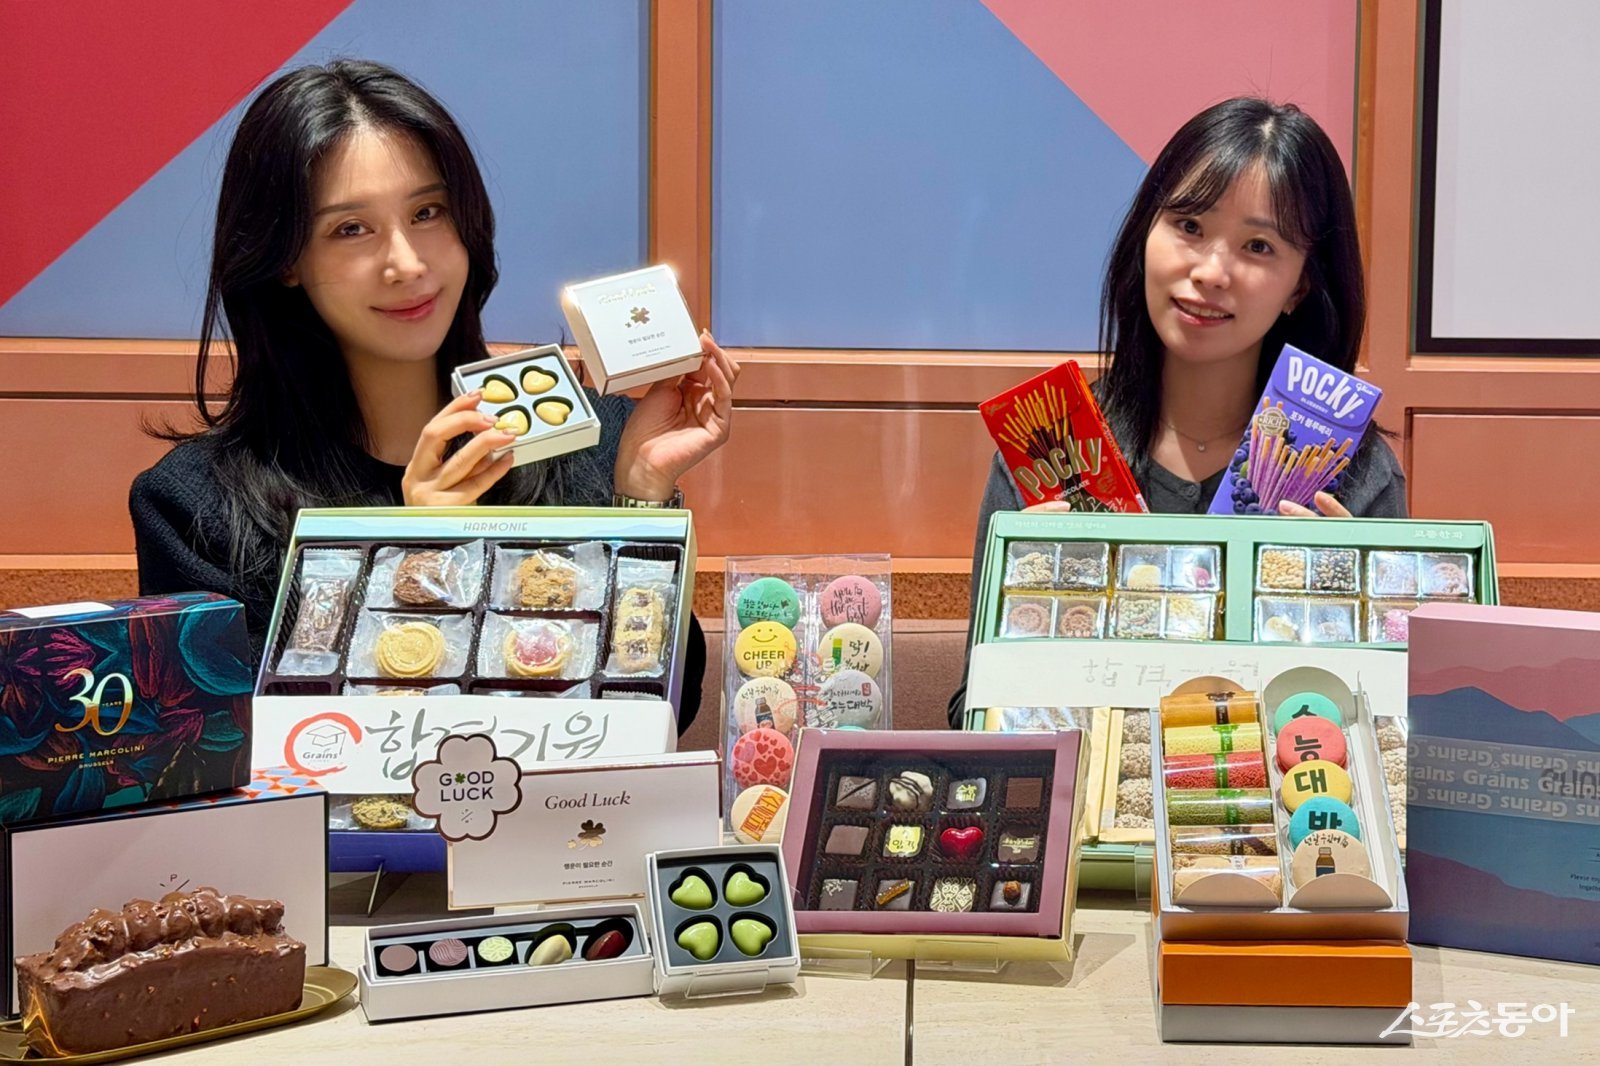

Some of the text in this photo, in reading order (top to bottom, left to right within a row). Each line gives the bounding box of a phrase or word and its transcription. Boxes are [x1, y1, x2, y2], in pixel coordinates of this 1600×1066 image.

[1289, 410, 1334, 437] 포키 블루베리
[463, 522, 529, 532] HARMONIE
[743, 650, 785, 661] CHEER
[756, 660, 772, 670] UP
[54, 667, 133, 736] 30
[47, 744, 145, 764] PIERRE MARCOLINI
[302, 751, 338, 760] Grains
[1426, 745, 1493, 767] Grains
[1502, 752, 1569, 773] Grains
[1407, 766, 1456, 782] rains
[1463, 769, 1530, 790] Grains
[440, 786, 494, 802] LUCK
[544, 790, 631, 810] Good Luck
[1426, 788, 1493, 810] Grains
[1501, 796, 1568, 817] Grains
[564, 860, 613, 870] 행운이 필요한 순간
